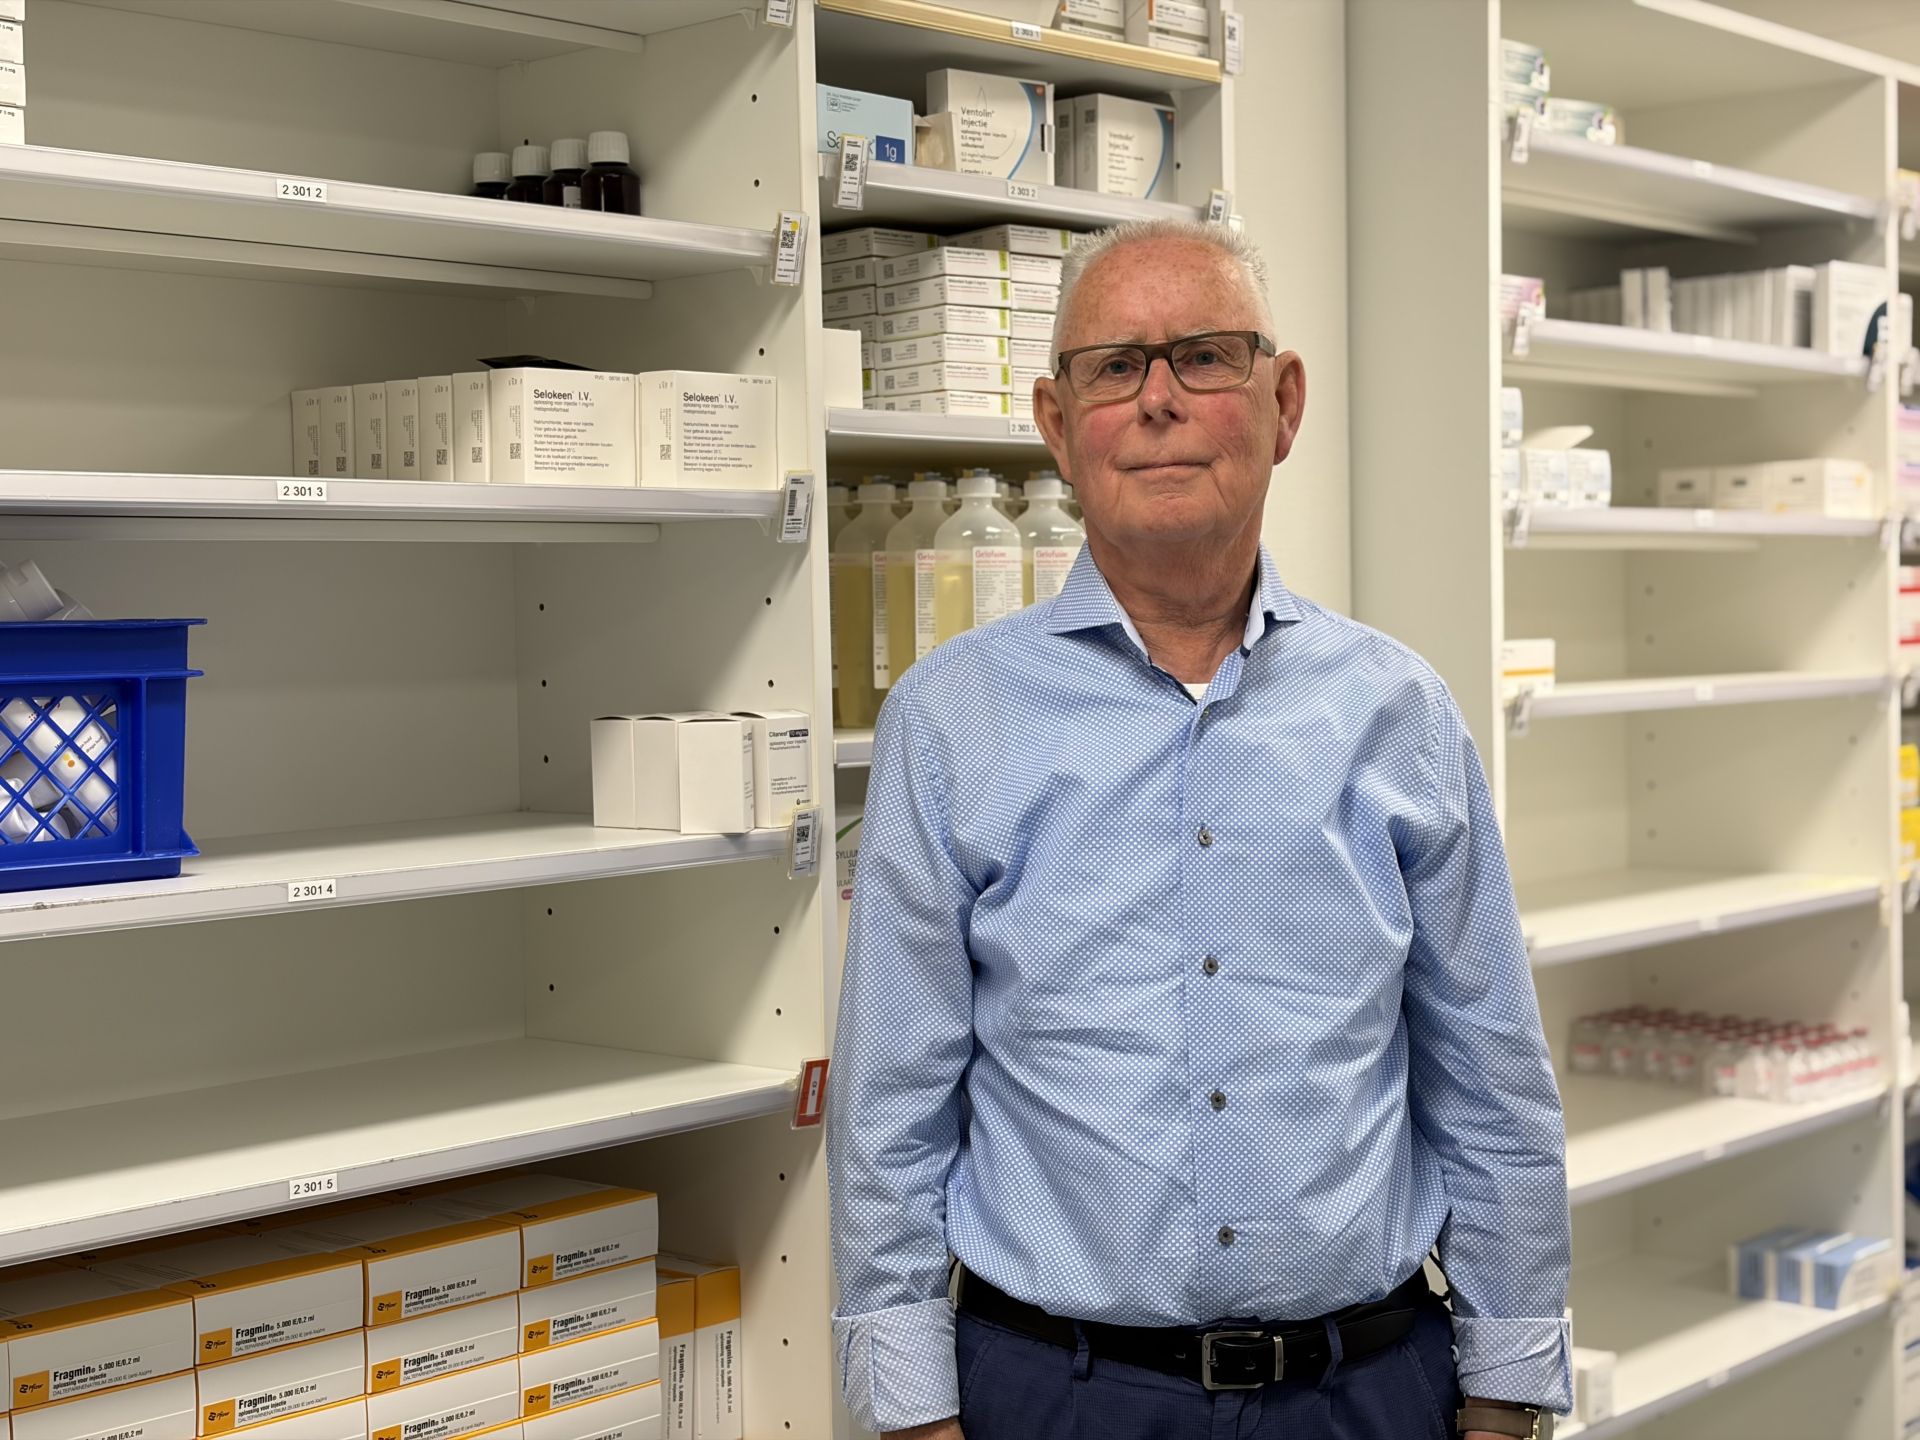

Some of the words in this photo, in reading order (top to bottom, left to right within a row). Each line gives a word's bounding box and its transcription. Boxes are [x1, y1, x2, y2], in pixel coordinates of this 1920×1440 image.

[961, 118, 988, 129] Injectie
[885, 143, 897, 162] 1g
[282, 184, 289, 194] 2
[292, 185, 311, 197] 301
[315, 187, 322, 198] 2
[1010, 186, 1016, 195] 2
[1017, 187, 1030, 197] 303
[1031, 189, 1036, 198] 2
[578, 391, 592, 401] I.V.
[725, 394, 737, 404] I.V.
[1011, 424, 1016, 432] 2
[1018, 424, 1030, 432] 303
[283, 485, 290, 496] 2
[293, 486, 312, 497] 301
[316, 486, 323, 497] 3
[836, 850, 858, 859] SYLLIU
[293, 887, 300, 897] 2
[303, 884, 322, 896] 301
[326, 884, 333, 894] 4
[293, 1184, 301, 1195] 2
[304, 1180, 322, 1193] 301
[326, 1178, 333, 1189] 5
